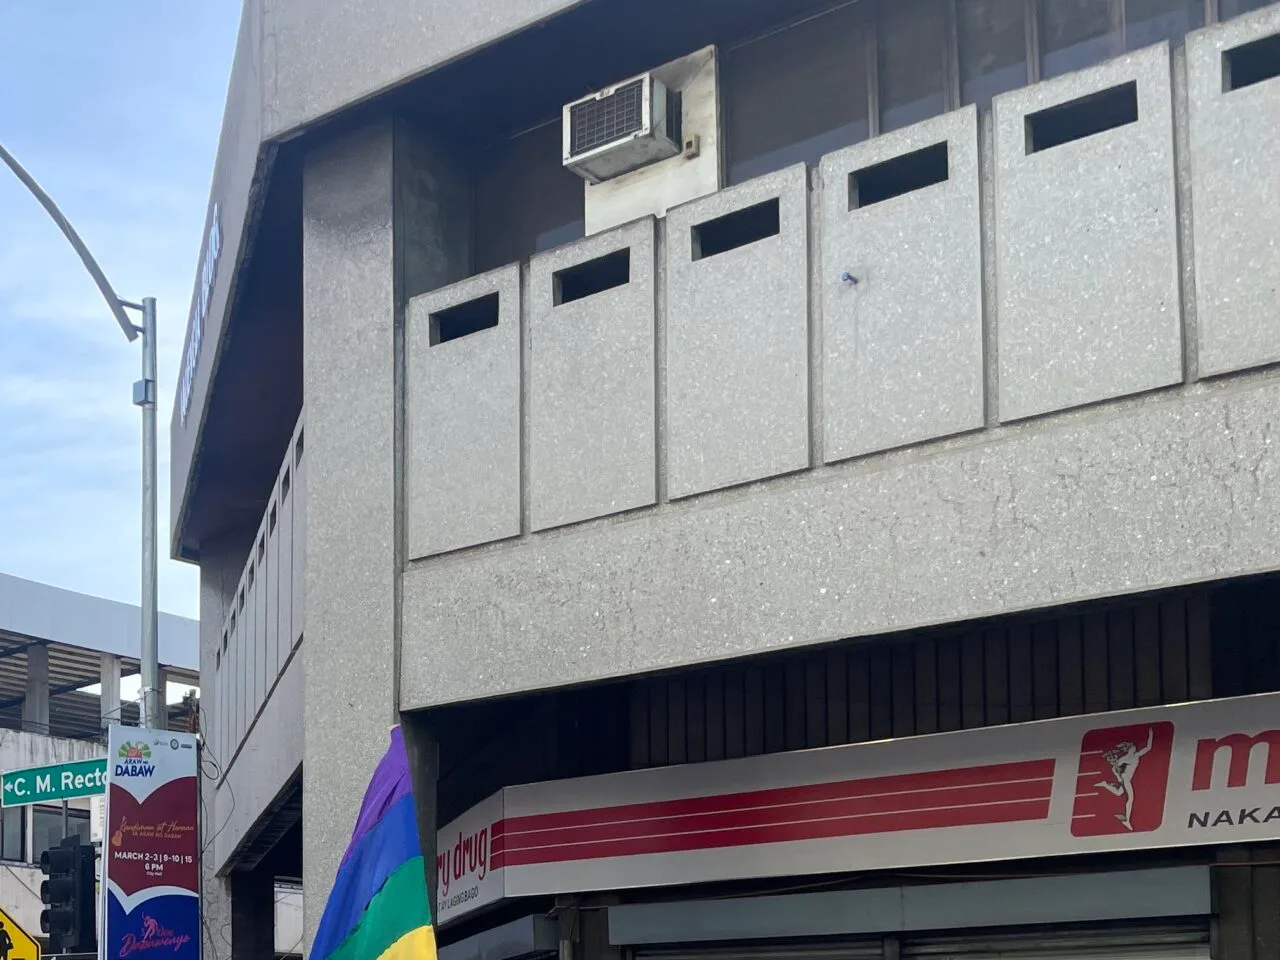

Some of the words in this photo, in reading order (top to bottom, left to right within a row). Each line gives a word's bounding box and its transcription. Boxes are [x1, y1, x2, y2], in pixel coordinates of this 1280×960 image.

[1191, 729, 1280, 791] m
[115, 764, 156, 777] DABAW
[14, 778, 31, 796] C.
[36, 773, 55, 793] M.
[114, 851, 144, 860] MARCH
[145, 853, 158, 861] 2-3
[185, 855, 193, 863] 15
[453, 827, 488, 881] drug
[145, 863, 150, 871] 6
[151, 863, 164, 872] PM
